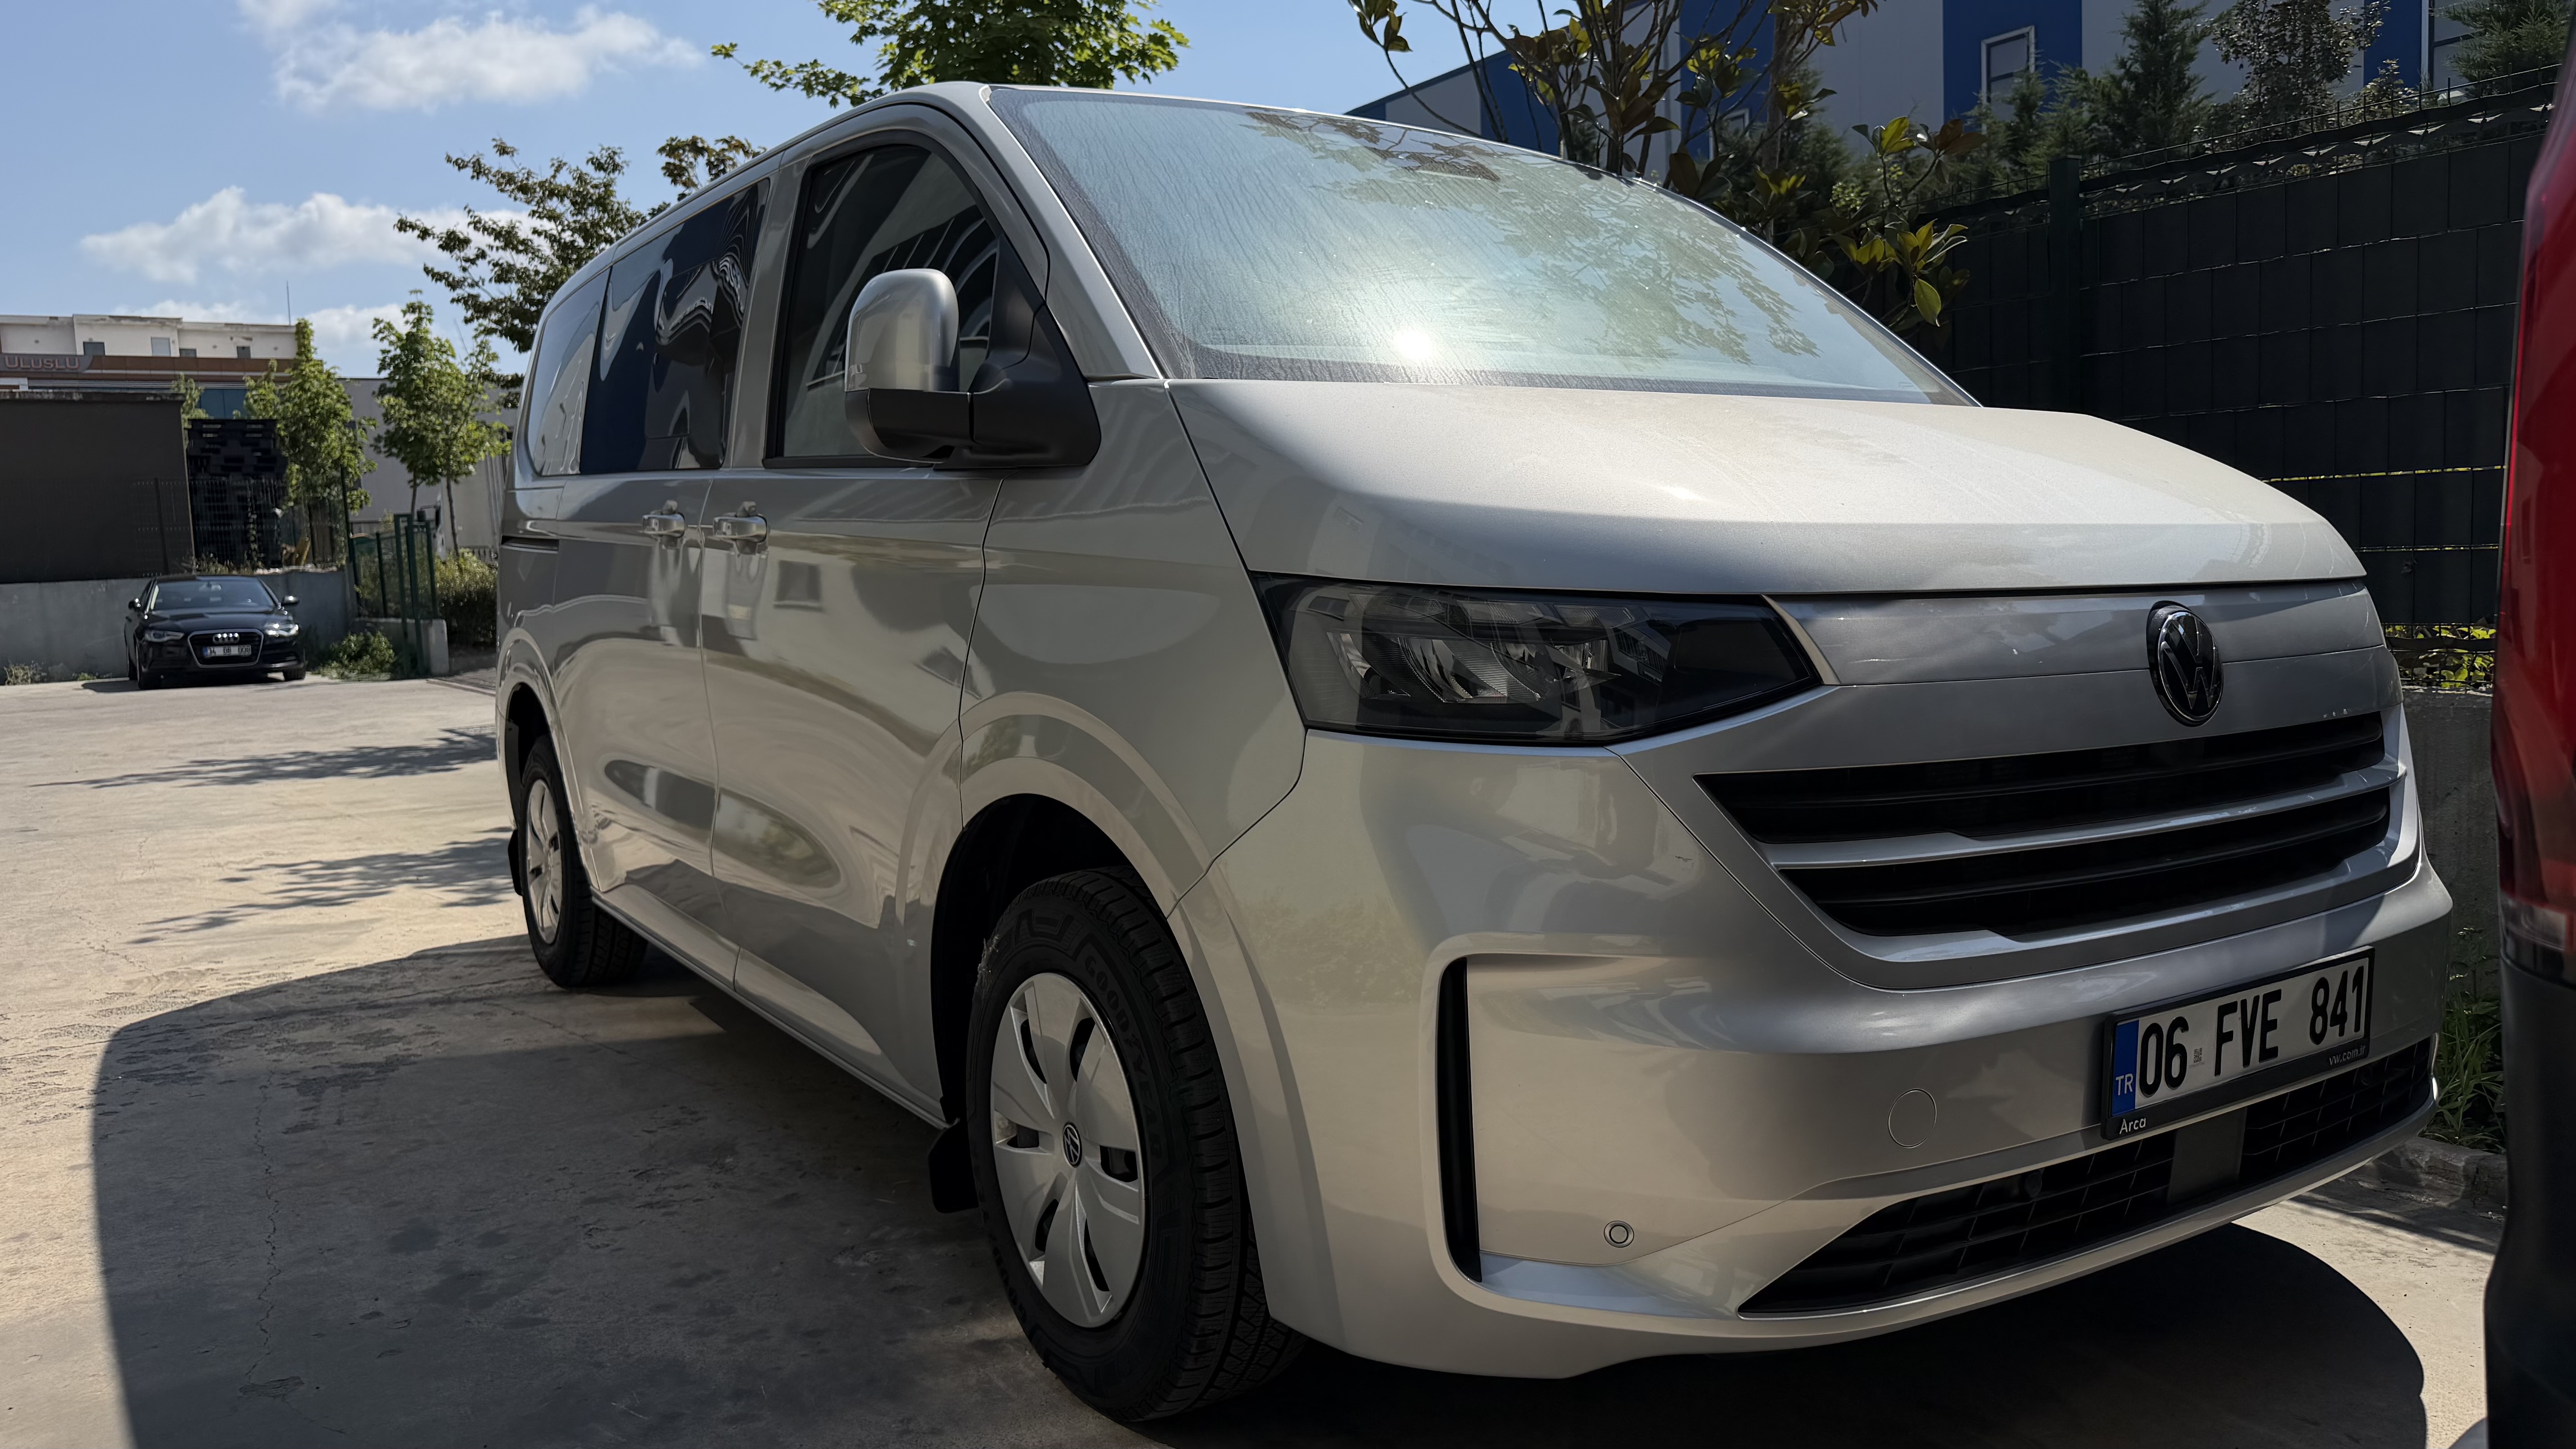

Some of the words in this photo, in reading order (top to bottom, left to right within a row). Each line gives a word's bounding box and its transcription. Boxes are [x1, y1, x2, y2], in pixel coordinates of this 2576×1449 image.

[5, 354, 79, 370] ULUSLU
[2139, 1016, 2189, 1098] 06
[2214, 989, 2282, 1077] FVE
[2309, 966, 2365, 1045] 841
[2116, 1072, 2134, 1096] TR
[2119, 1117, 2147, 1135] Arca
